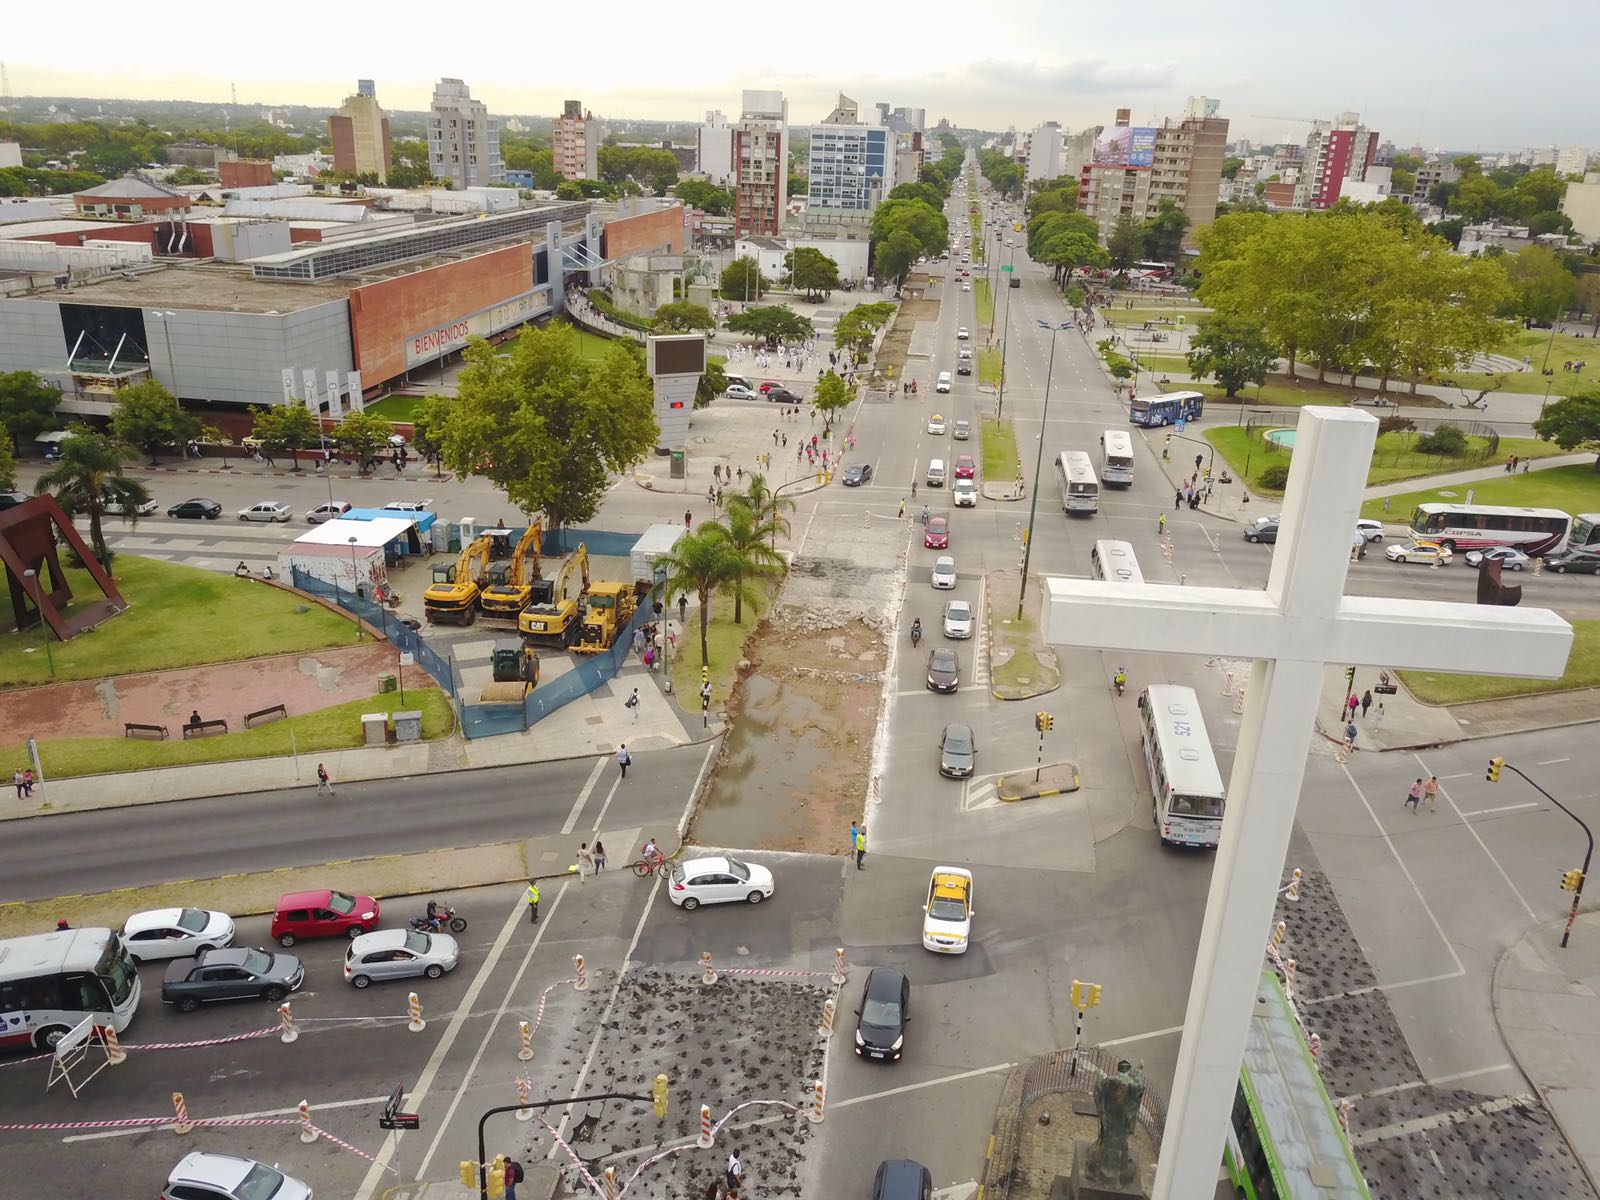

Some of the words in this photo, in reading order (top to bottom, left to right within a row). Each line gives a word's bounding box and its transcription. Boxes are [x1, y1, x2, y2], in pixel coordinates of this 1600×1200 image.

[415, 320, 469, 354] BIENVENIDOS
[531, 621, 545, 631] CAT
[1174, 721, 1191, 736] 521
